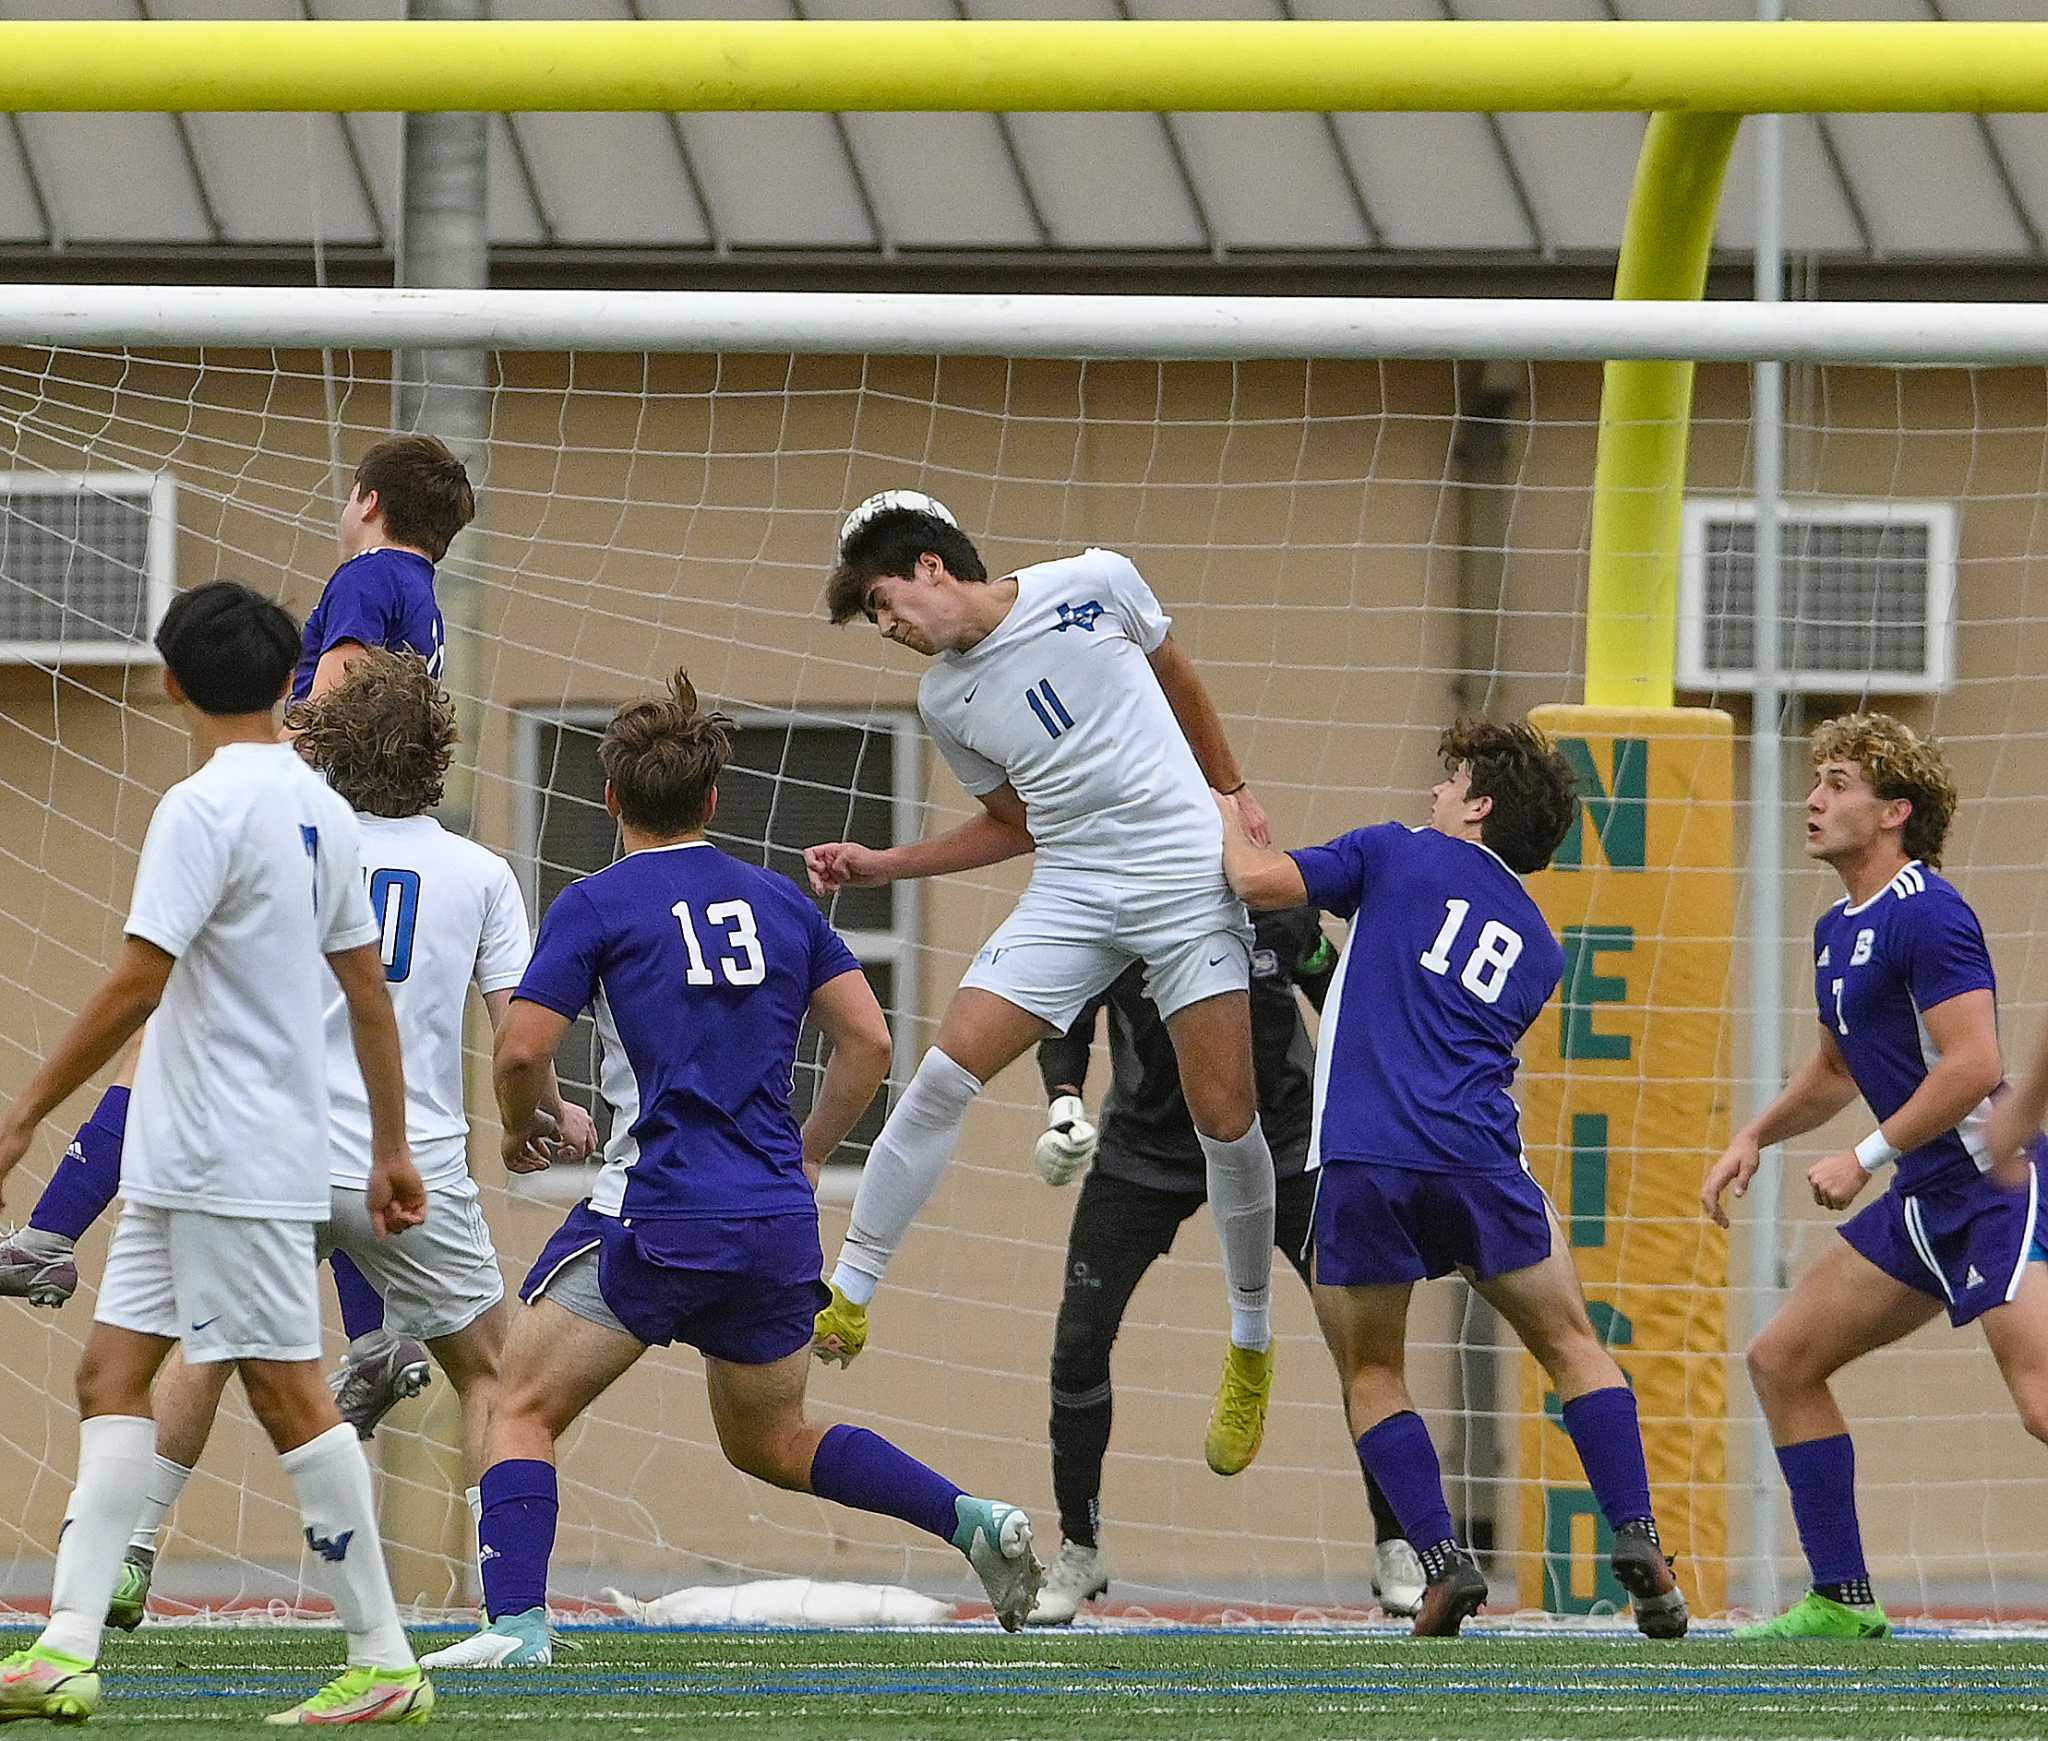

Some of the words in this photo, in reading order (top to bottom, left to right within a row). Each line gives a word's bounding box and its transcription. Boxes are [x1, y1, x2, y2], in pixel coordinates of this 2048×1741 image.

[1025, 677, 1075, 740] 11
[363, 867, 421, 983] 0
[671, 899, 766, 985] 13
[1419, 899, 1523, 1003] 18
